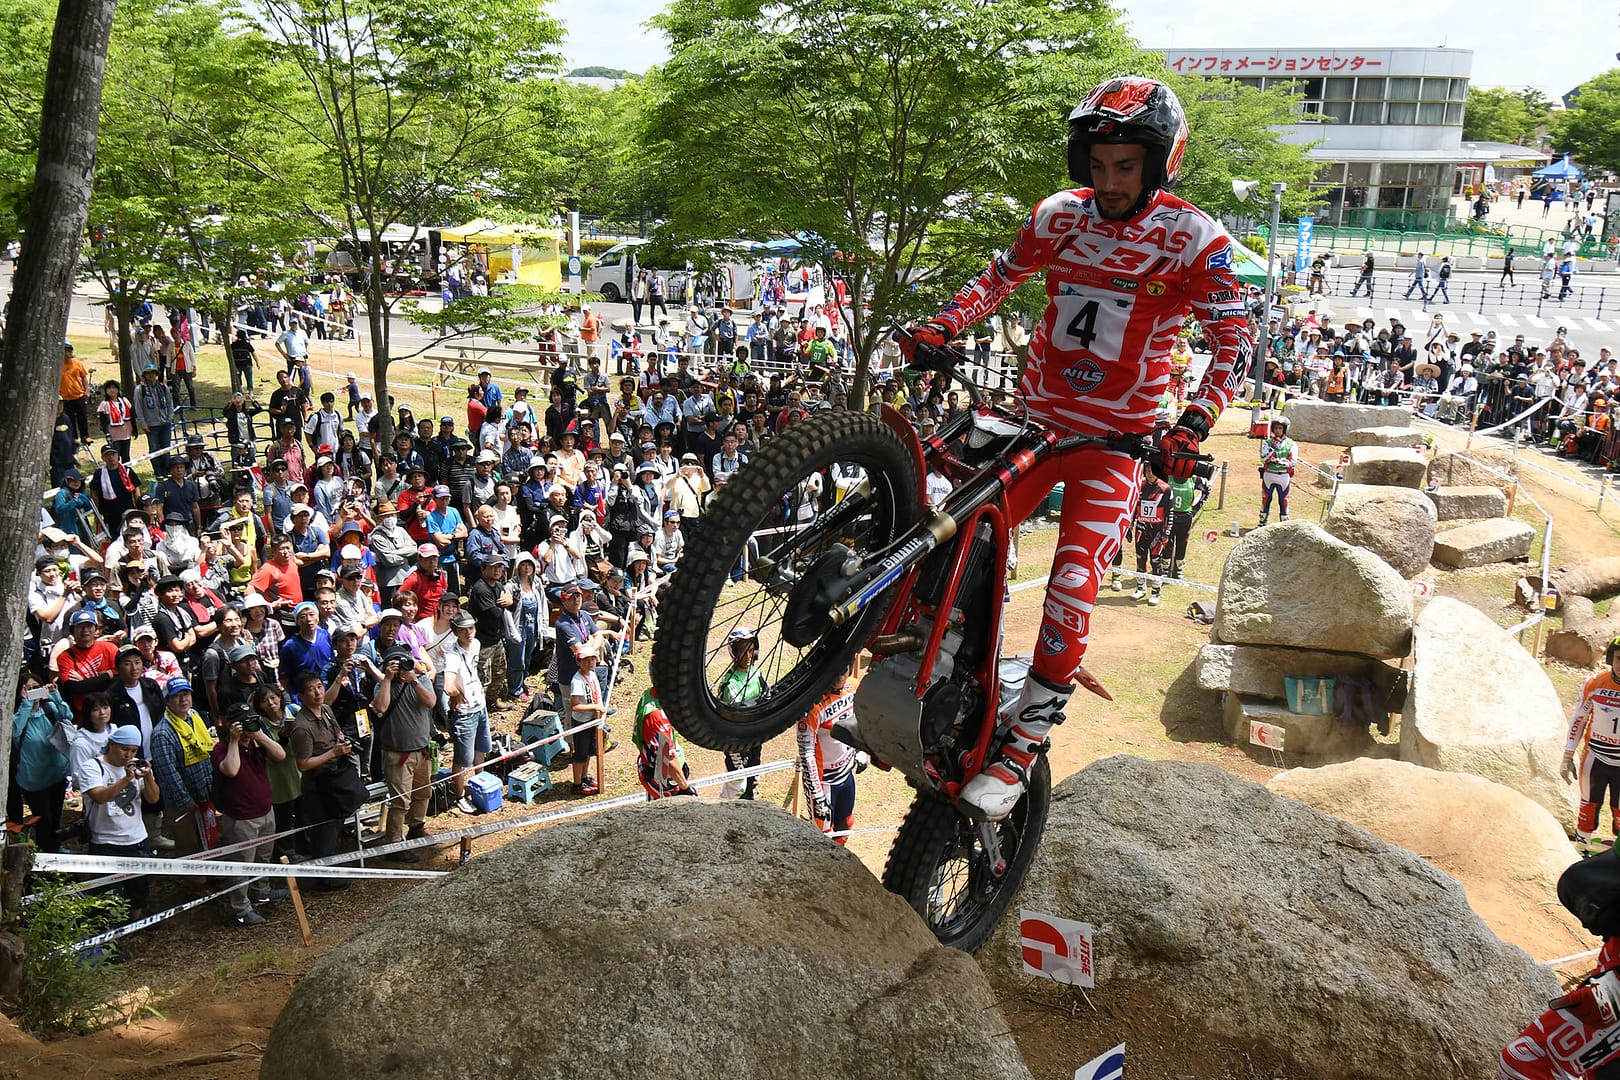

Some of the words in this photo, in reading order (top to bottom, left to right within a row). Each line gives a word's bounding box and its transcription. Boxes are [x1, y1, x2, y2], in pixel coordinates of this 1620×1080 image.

[1172, 56, 1382, 71] インフォメーションセンター
[1047, 212, 1193, 254] GASGAS
[1299, 222, 1312, 267] フマキラー
[1221, 308, 1246, 317] MICHE
[1067, 301, 1099, 348] 4
[814, 352, 822, 360] 97
[1062, 368, 1104, 382] NILS
[1175, 496, 1182, 508] 9
[1143, 506, 1154, 516] 97
[1600, 689, 1620, 698] REP
[824, 694, 855, 719] REPSO
[1611, 717, 1619, 735] 1
[1592, 731, 1620, 745] HON
